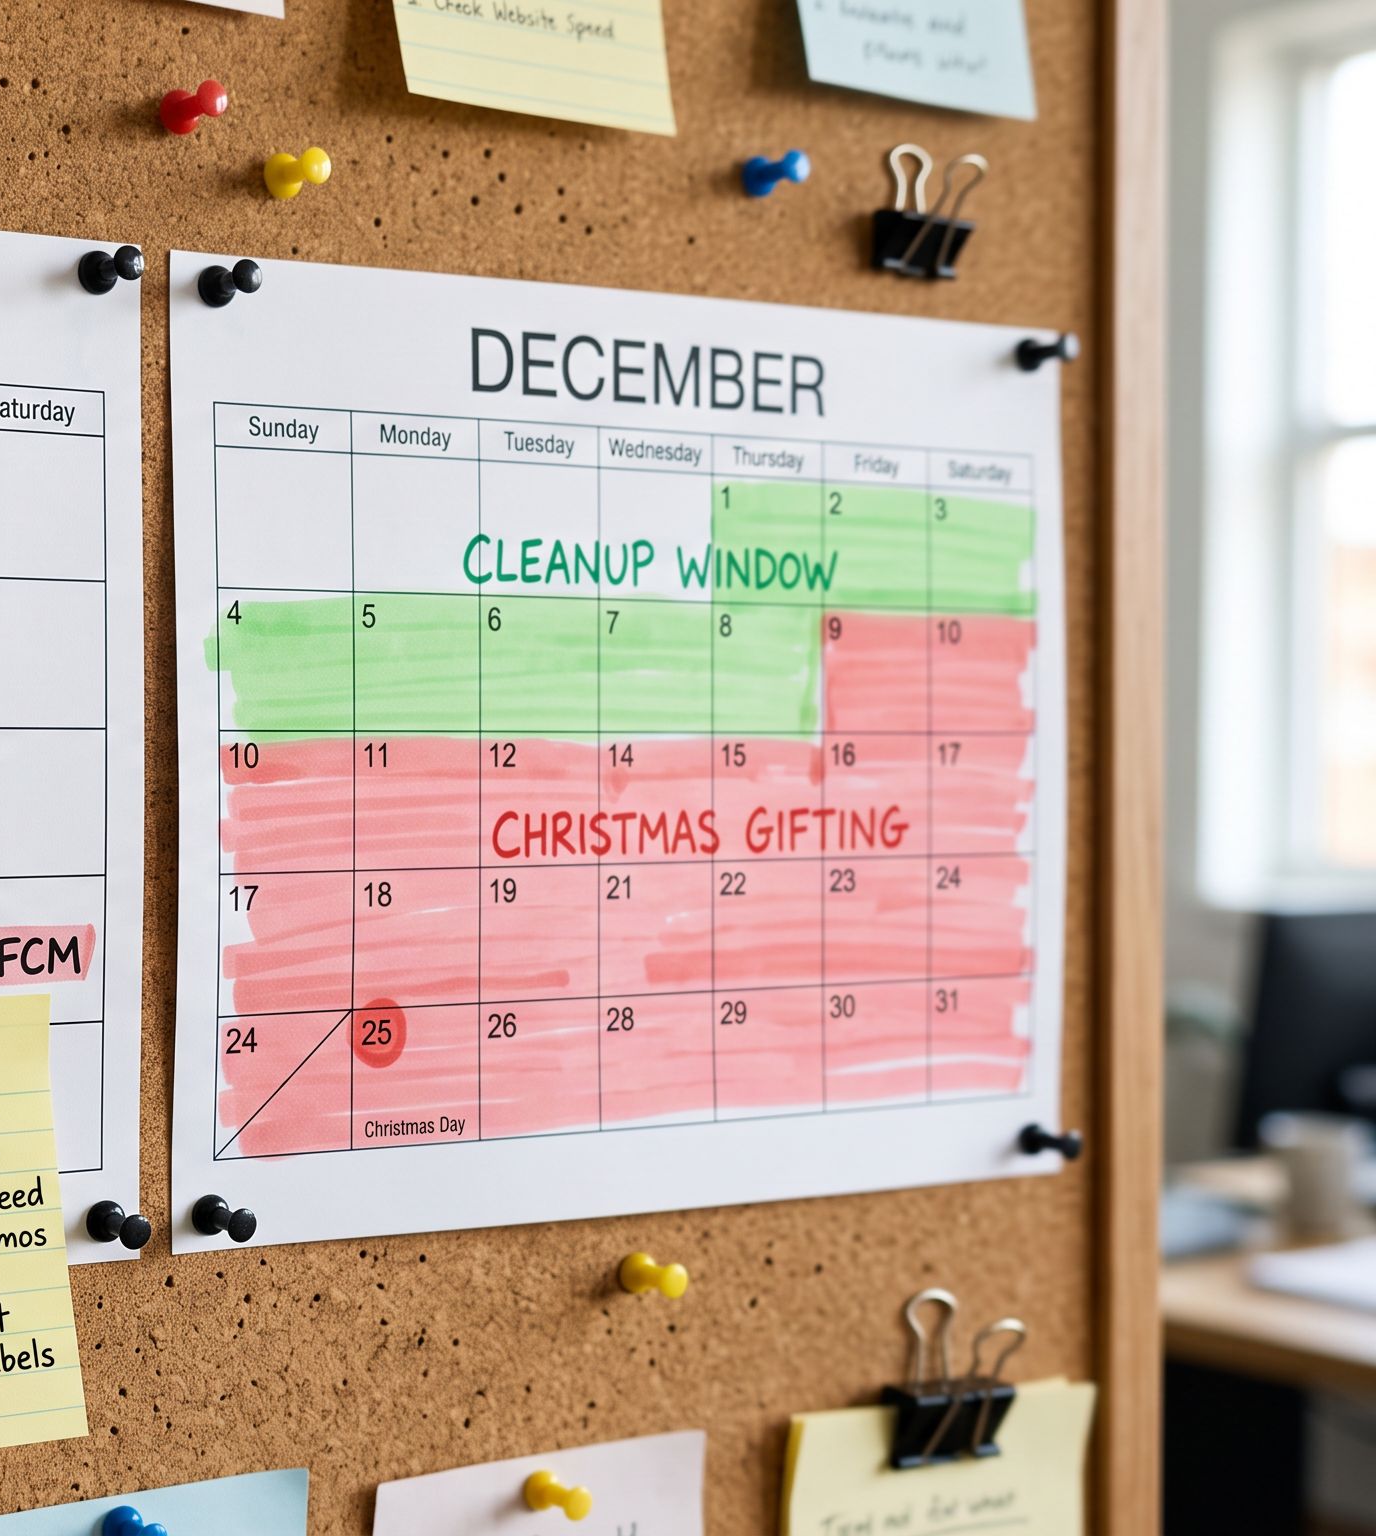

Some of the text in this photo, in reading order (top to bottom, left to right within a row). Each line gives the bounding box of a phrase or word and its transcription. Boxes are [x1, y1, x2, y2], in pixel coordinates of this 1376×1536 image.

[493, 2, 557, 30] Website
[566, 13, 615, 42] Speed
[471, 327, 826, 417] DECEMBER
[248, 415, 319, 444] Sunday
[380, 424, 452, 451] Monday
[504, 431, 575, 459] Tuesday
[608, 436, 703, 467] Wednesday
[733, 446, 804, 472] Thursday
[854, 454, 899, 478] Friday
[947, 461, 1013, 484] Saturday
[721, 486, 731, 509] 1
[829, 492, 842, 516] 2
[934, 499, 947, 521] 3
[462, 533, 839, 592] CLEANUP WINDOW
[226, 599, 242, 626] 4
[362, 604, 376, 628] 5
[488, 607, 502, 632] 6
[606, 610, 619, 635] 7
[719, 614, 732, 637] 8
[828, 617, 842, 640] 9
[937, 621, 961, 644] 10
[229, 742, 259, 769] 10
[364, 743, 389, 768] 11
[489, 743, 516, 768] 12
[608, 743, 634, 767] 14
[721, 744, 746, 767] 15
[830, 743, 855, 766] 16
[937, 742, 961, 765] 17
[492, 804, 910, 859] CHRISTMAS GIFTING
[489, 878, 517, 903] 19
[606, 875, 632, 900] 21
[720, 872, 747, 896] 22
[830, 869, 855, 892] 23
[936, 866, 961, 890] 24
[229, 885, 259, 912] 17
[364, 882, 392, 908] 18
[720, 1001, 747, 1025] 29
[829, 995, 855, 1019] 30
[935, 990, 959, 1013] 31
[488, 1013, 517, 1039] 26
[606, 1008, 634, 1032] 28
[225, 1028, 258, 1055] 24
[362, 1020, 392, 1046] 25
[364, 1116, 465, 1138] Christmas Day
